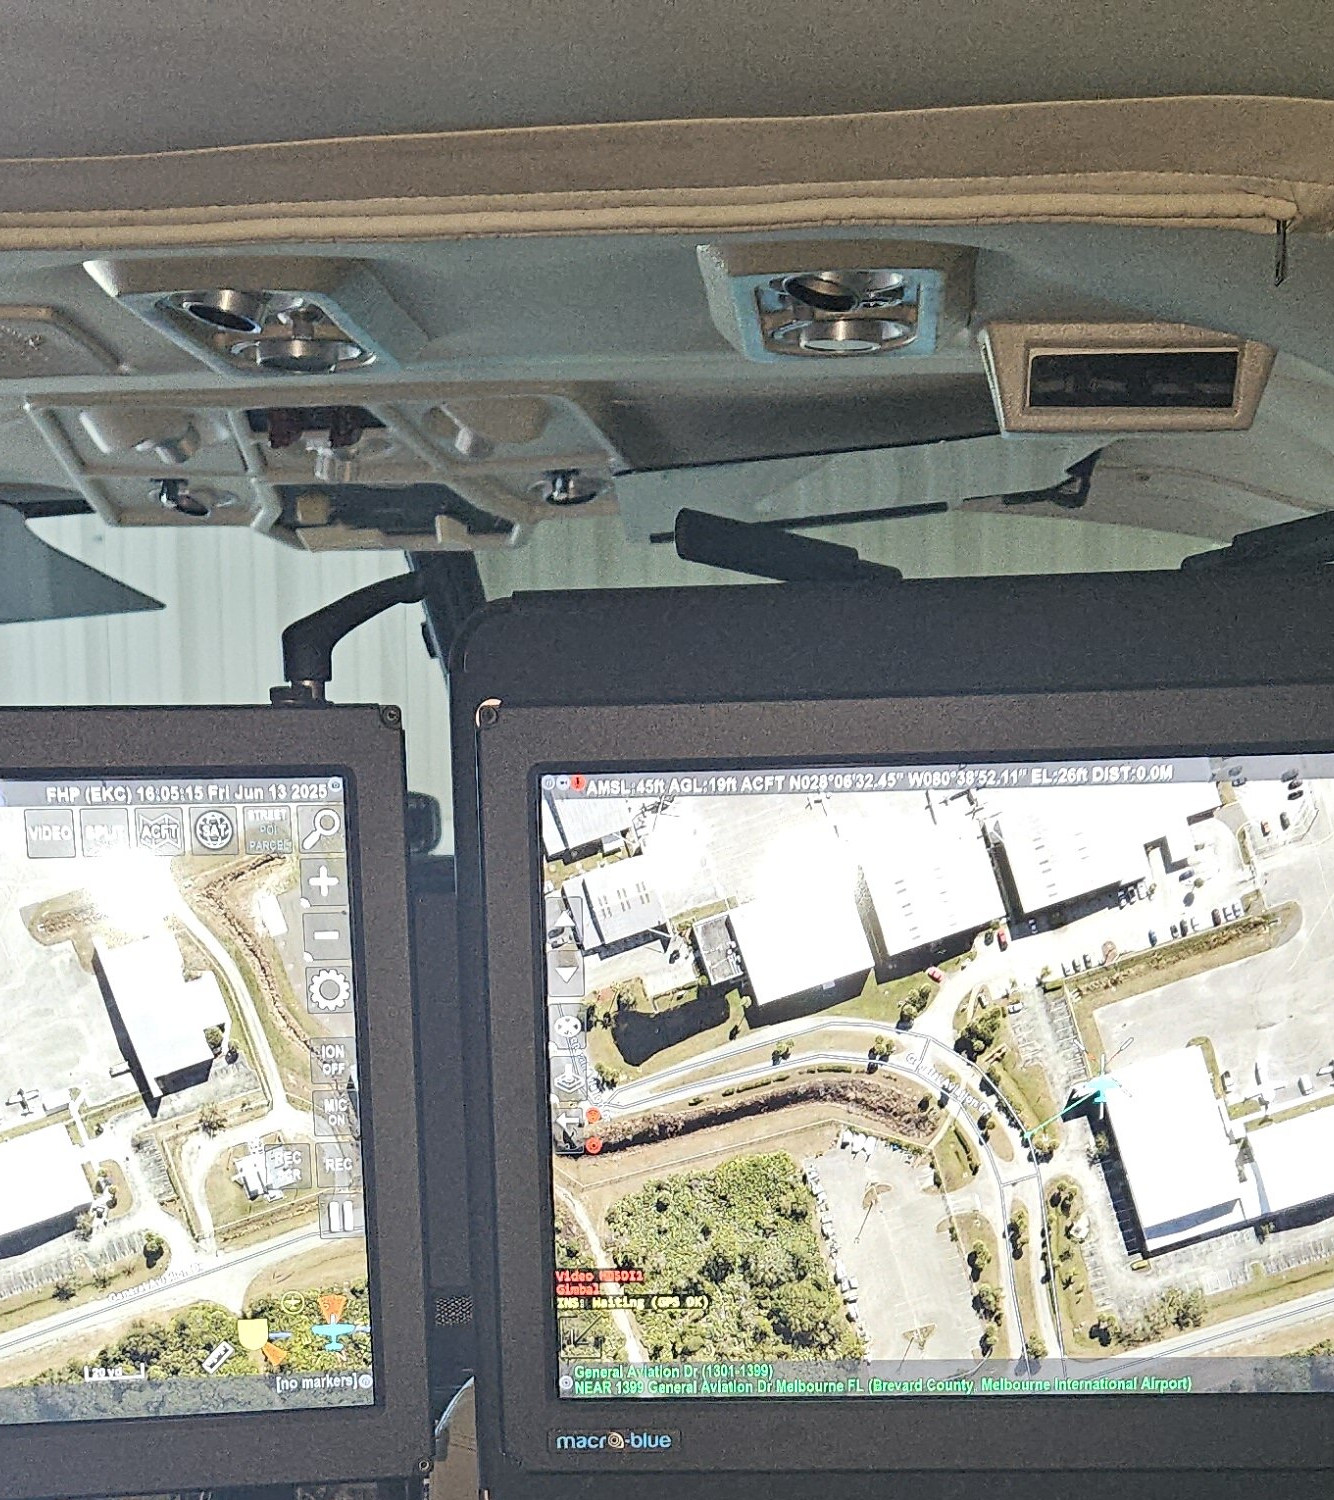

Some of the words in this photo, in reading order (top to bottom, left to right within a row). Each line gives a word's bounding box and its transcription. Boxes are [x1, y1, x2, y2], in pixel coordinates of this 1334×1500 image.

[586, 780, 665, 796] AMSL:45ft
[669, 778, 737, 794] AGL:19ft
[740, 777, 784, 793] ACFT
[1031, 768, 1088, 784] EL:26ft
[1092, 766, 1173, 783] DIST:0.0M
[45, 786, 80, 803] FHP
[85, 786, 132, 804] (EKC)
[137, 785, 203, 801] 16:05:15
[208, 785, 231, 801] Fri
[234, 785, 264, 800] Jun
[268, 785, 287, 800] 13
[291, 784, 328, 799] 2025
[28, 824, 73, 841] VIDEO
[141, 823, 178, 841] ACFT
[202, 823, 227, 839] SAT
[321, 1044, 344, 1059] ION
[322, 1062, 345, 1075] OFF
[323, 1099, 347, 1113] MIC
[328, 1114, 345, 1126] ON
[325, 1157, 352, 1172] REC
[555, 1270, 594, 1282] Video
[556, 1283, 600, 1296] Gimbal
[592, 1296, 645, 1310] Waiting
[574, 1365, 624, 1379] General
[627, 1365, 680, 1379] Aviation
[684, 1364, 698, 1378] Dr
[702, 1363, 774, 1380] (1301-1399)
[276, 1376, 298, 1394] [no
[302, 1373, 357, 1390] markers]
[574, 1380, 611, 1395] NEAR
[616, 1380, 644, 1394] 1399
[648, 1380, 697, 1394] General
[701, 1379, 753, 1394] Aviation
[758, 1380, 772, 1393] Dr
[776, 1379, 844, 1393] Melbourne
[848, 1379, 864, 1392] FL
[868, 1378, 922, 1394] (Brevard
[926, 1378, 977, 1394] County,
[981, 1377, 1051, 1391] Melbourne
[1054, 1376, 1137, 1391] International
[1140, 1376, 1192, 1393] Airport)
